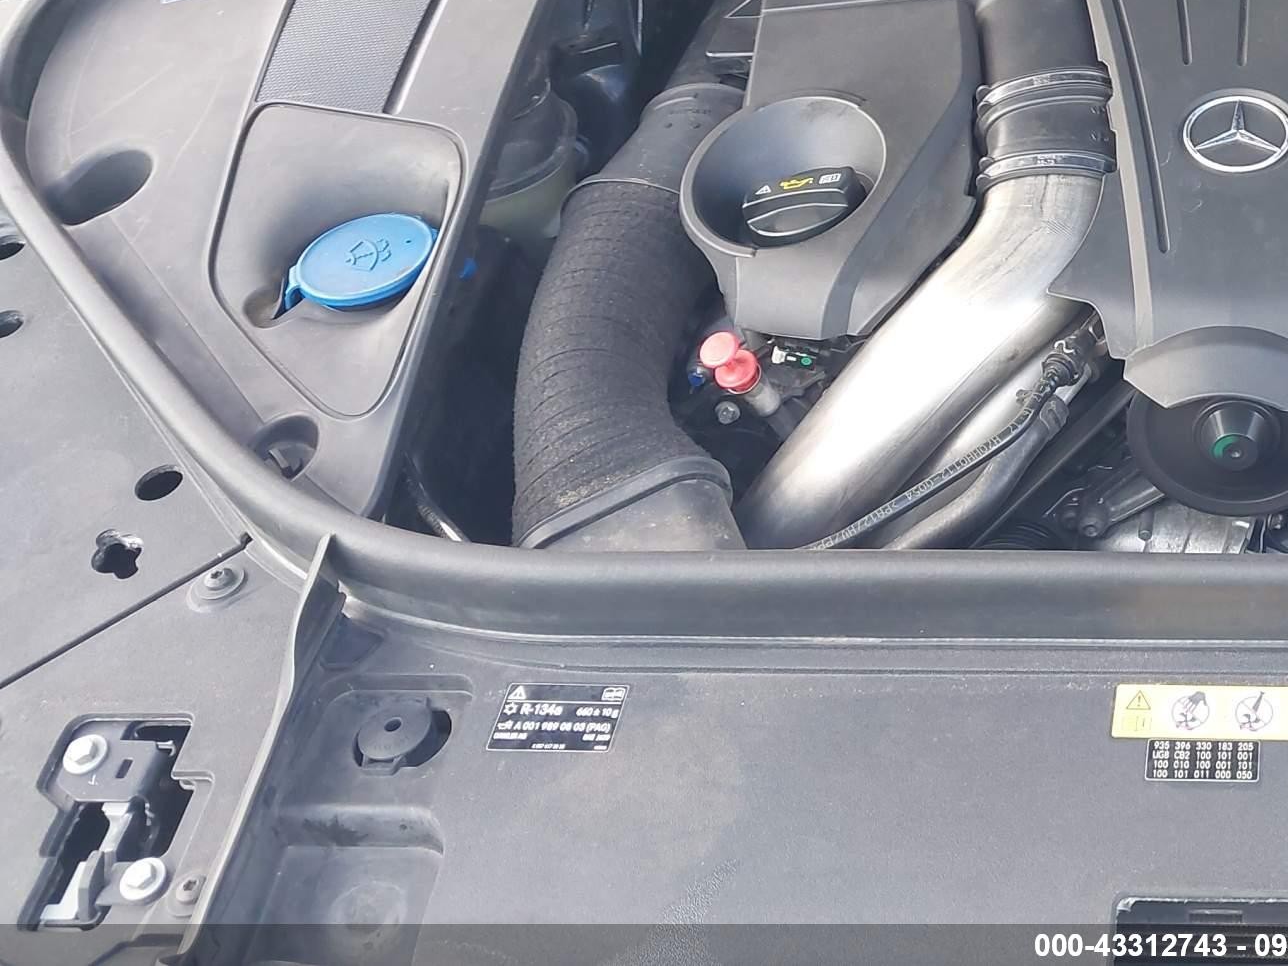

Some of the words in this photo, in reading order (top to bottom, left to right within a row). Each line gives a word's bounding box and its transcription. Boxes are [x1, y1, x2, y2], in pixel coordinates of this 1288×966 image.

[520, 703, 563, 715] R-134a
[602, 708, 612, 717] 10
[513, 721, 521, 731] A
[522, 722, 540, 731] 001
[586, 722, 612, 733] (PAG)
[1154, 741, 1170, 750] 935
[1174, 741, 1191, 750] 396
[1196, 742, 1212, 751] 330
[1218, 742, 1233, 751] 183
[1196, 751, 1212, 760] 100
[1217, 751, 1232, 760] 101
[1237, 751, 1253, 761] 001
[1154, 760, 1169, 769] 100
[1173, 760, 1190, 769] 010
[1196, 760, 1211, 770] 100
[1215, 760, 1232, 770] 001
[1238, 761, 1252, 770] 101
[1153, 769, 1168, 778] 100
[1174, 770, 1188, 778] 101
[1194, 770, 1209, 779] 011
[1215, 770, 1231, 779] 000
